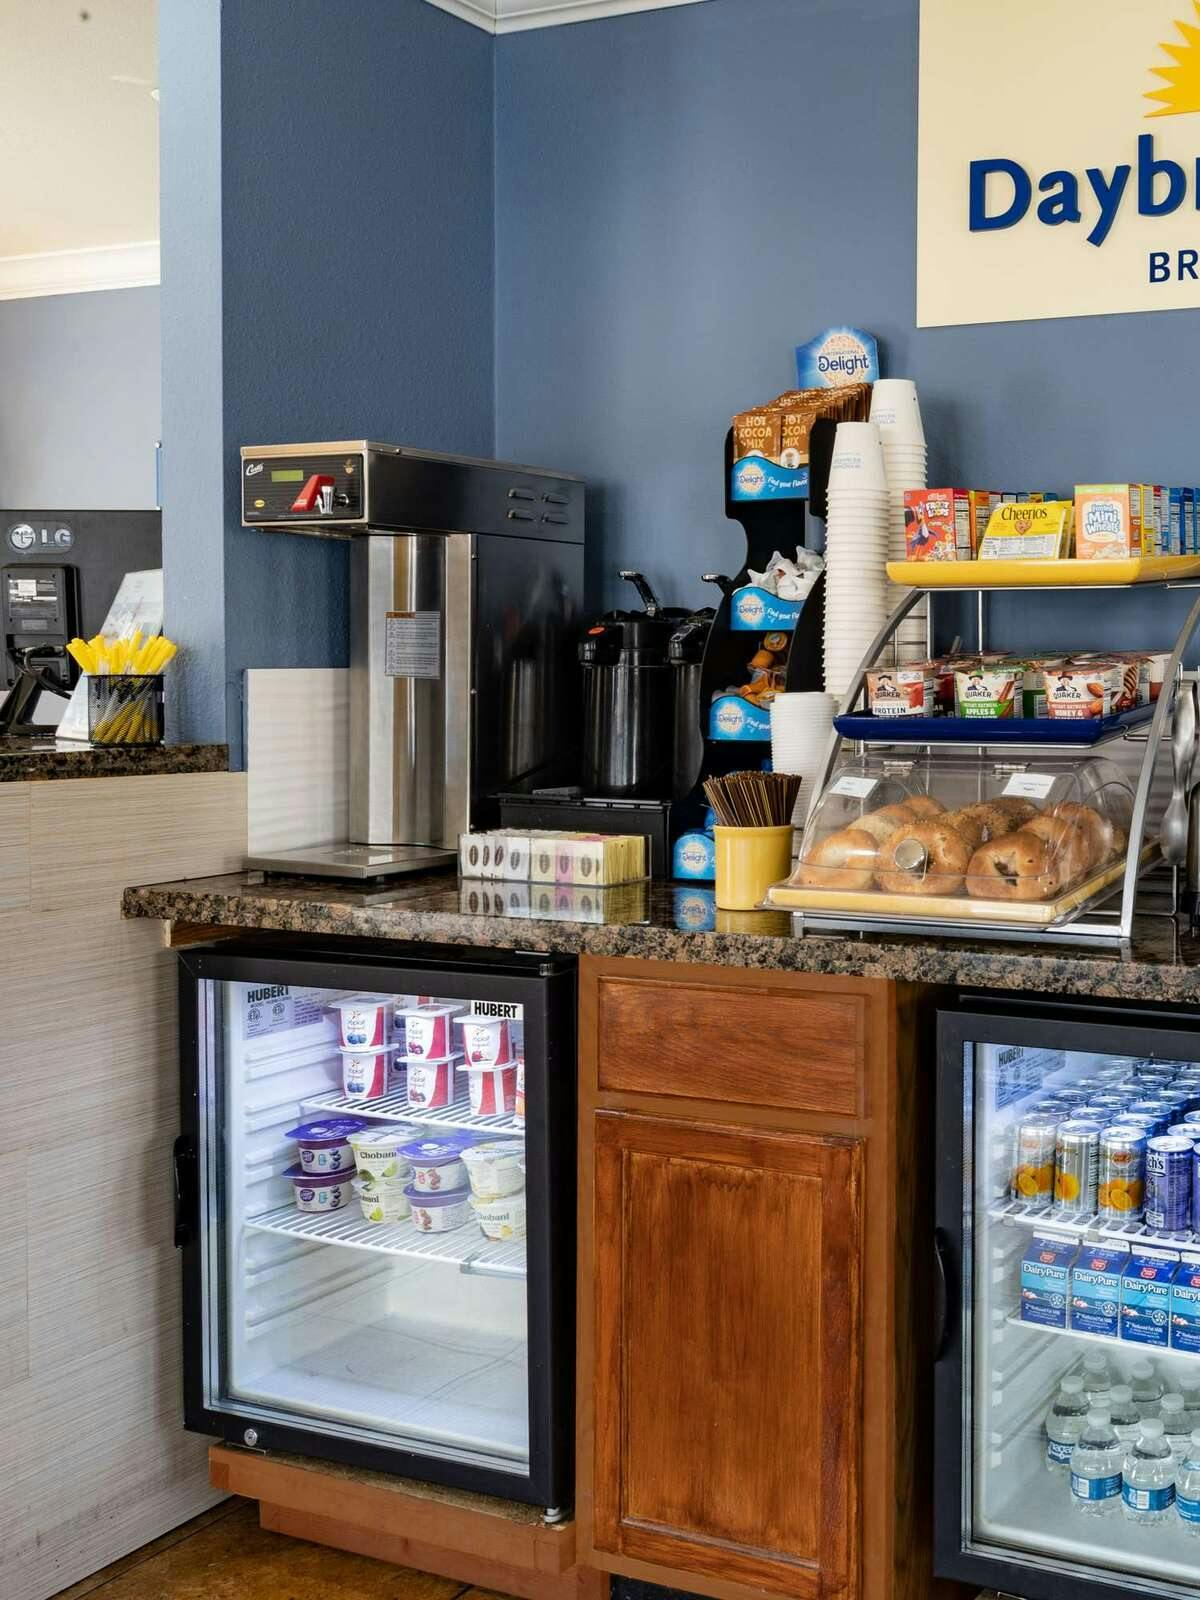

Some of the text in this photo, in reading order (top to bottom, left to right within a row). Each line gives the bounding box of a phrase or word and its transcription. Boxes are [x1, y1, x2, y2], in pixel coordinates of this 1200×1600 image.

[818, 354, 869, 375] Delight
[746, 415, 767, 426] HOT
[740, 427, 772, 437] COCOA
[747, 438, 765, 449] MIX
[1001, 507, 1048, 521] Cheerios
[1087, 509, 1119, 525] Mini
[41, 528, 72, 547] LG
[875, 691, 901, 699] QUAKER
[965, 691, 992, 699] QUAKER
[1053, 691, 1082, 699] QUAKER
[248, 984, 289, 1003] HUBERT
[474, 1002, 518, 1018] HUBERT
[1148, 1155, 1164, 1170] ch's
[1023, 1263, 1064, 1278] DairyPure
[1075, 1271, 1117, 1287] DairyPure
[1124, 1280, 1168, 1294] DairyPure
